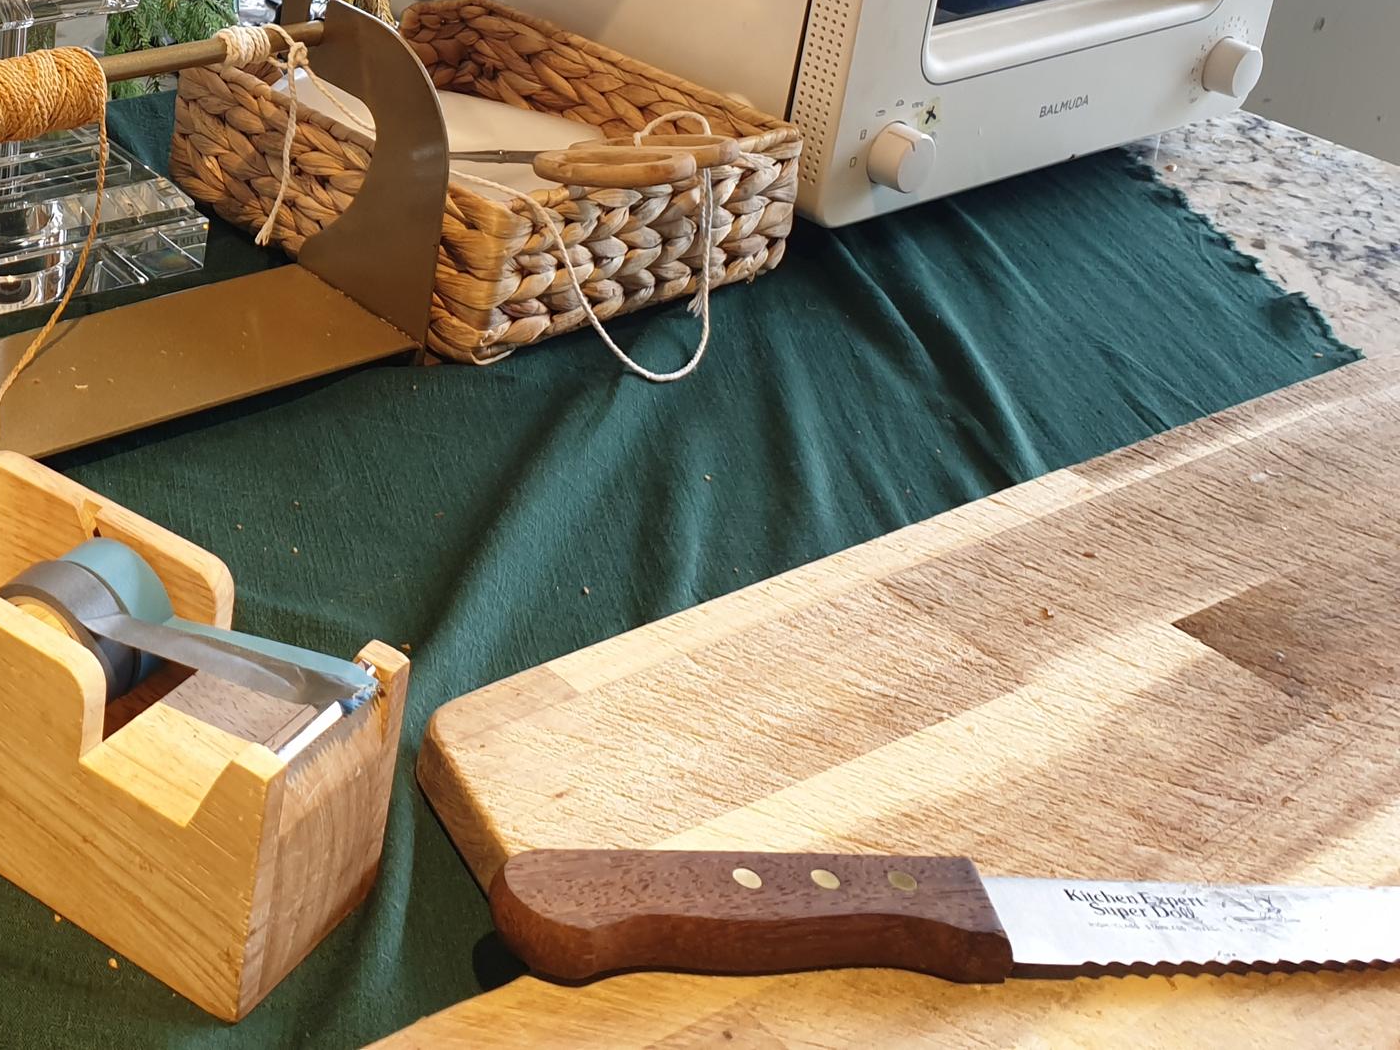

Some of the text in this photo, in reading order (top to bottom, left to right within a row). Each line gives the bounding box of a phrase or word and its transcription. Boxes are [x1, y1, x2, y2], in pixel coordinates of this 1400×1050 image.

[1039, 94, 1089, 119] BALMUDA
[1063, 888, 1208, 910] Kitchen Expert
[1089, 902, 1148, 920] Super
